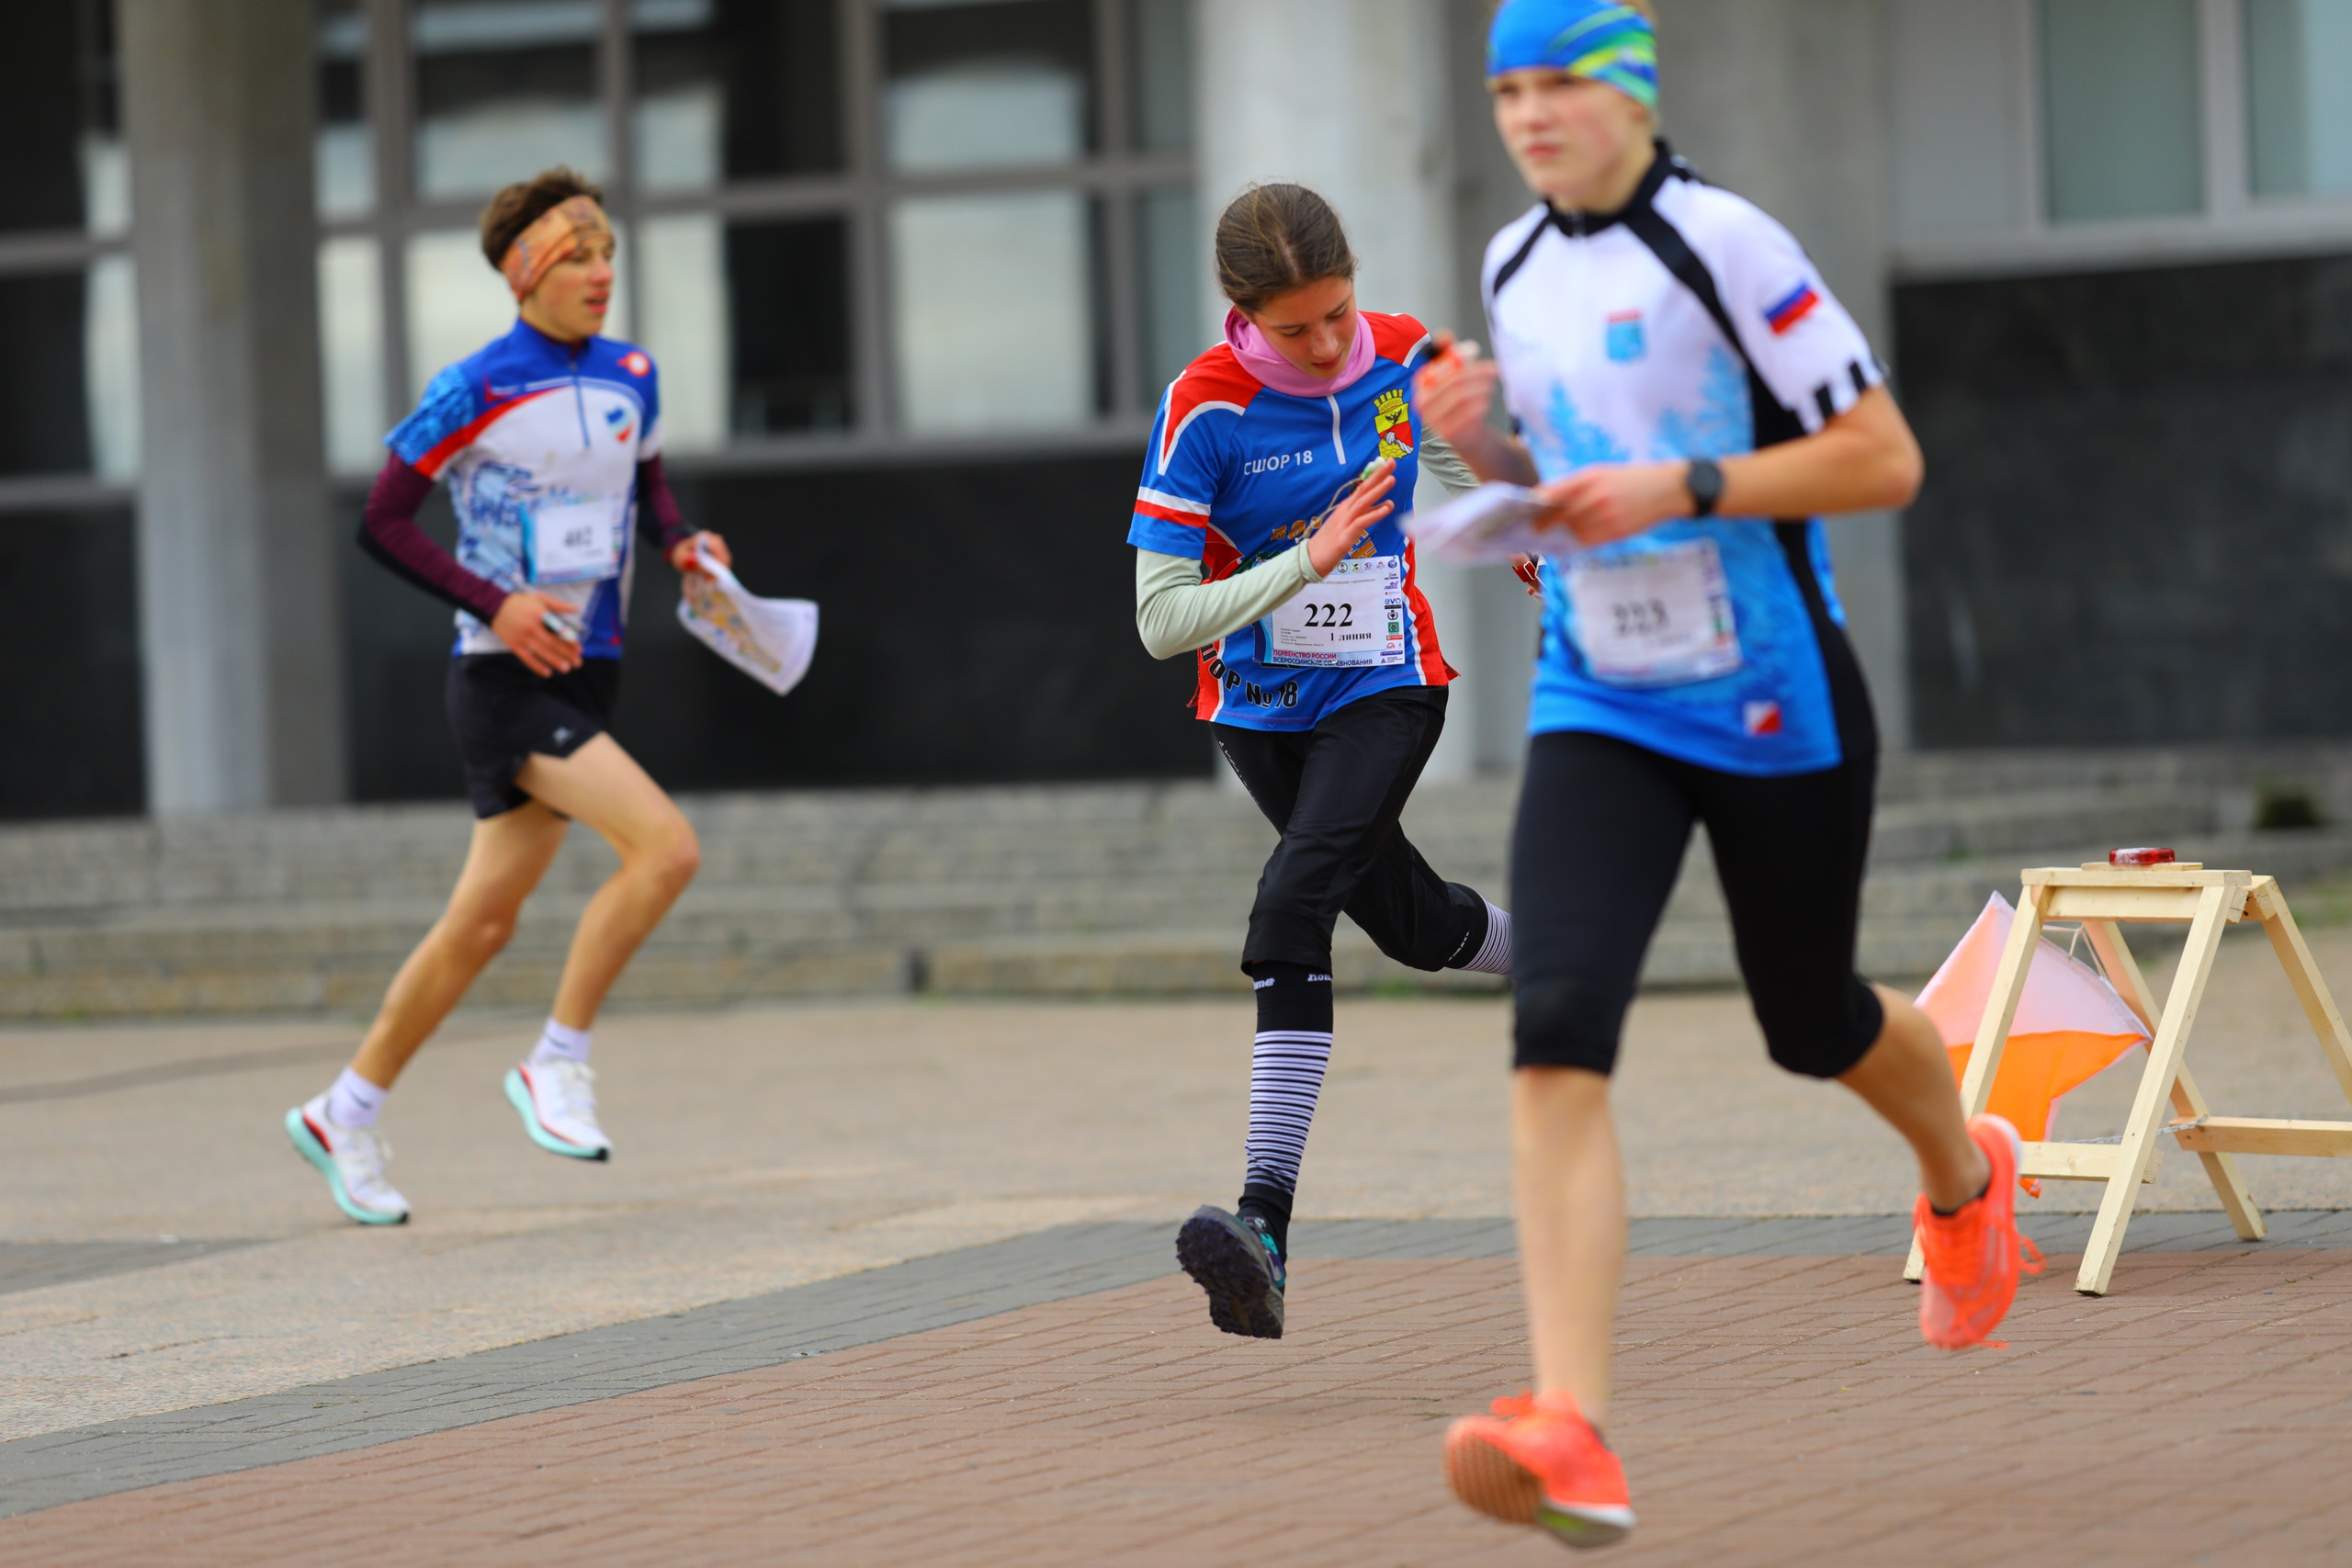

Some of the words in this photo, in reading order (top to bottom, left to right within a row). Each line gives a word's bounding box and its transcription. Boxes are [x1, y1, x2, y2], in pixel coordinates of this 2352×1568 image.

[1244, 454, 1290, 475] СШОР
[1295, 450, 1313, 464] 18
[1304, 603, 1352, 626] 222
[1330, 632, 1334, 641] 1
[1339, 632, 1372, 641] линия
[1272, 649, 1311, 659] ПЕРВЕНСТВО
